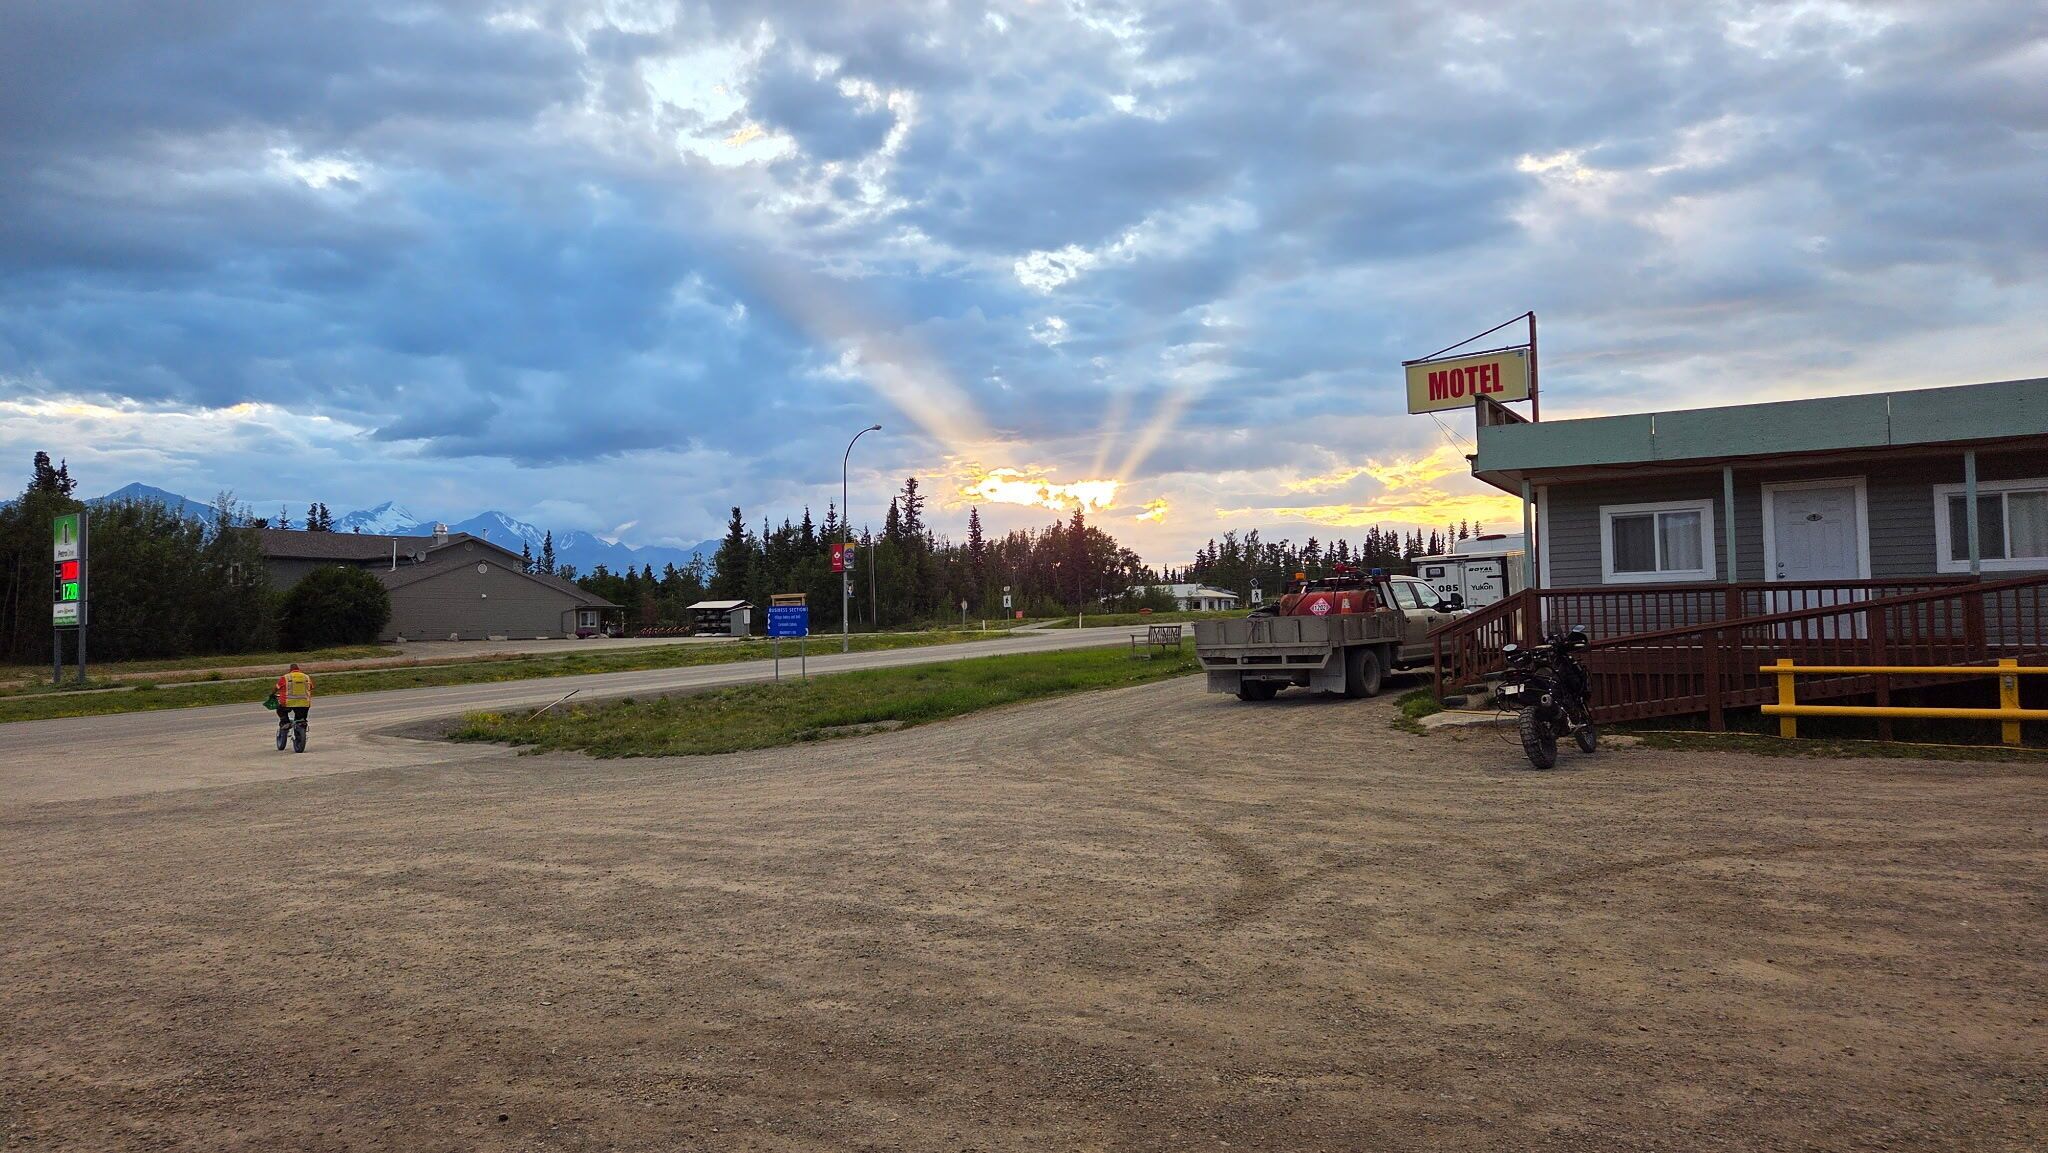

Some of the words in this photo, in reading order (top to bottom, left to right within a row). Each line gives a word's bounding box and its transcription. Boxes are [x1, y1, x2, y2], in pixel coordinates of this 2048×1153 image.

[1428, 363, 1504, 401] MOTEL
[1438, 584, 1459, 593] 085
[1470, 582, 1494, 591] Yukon
